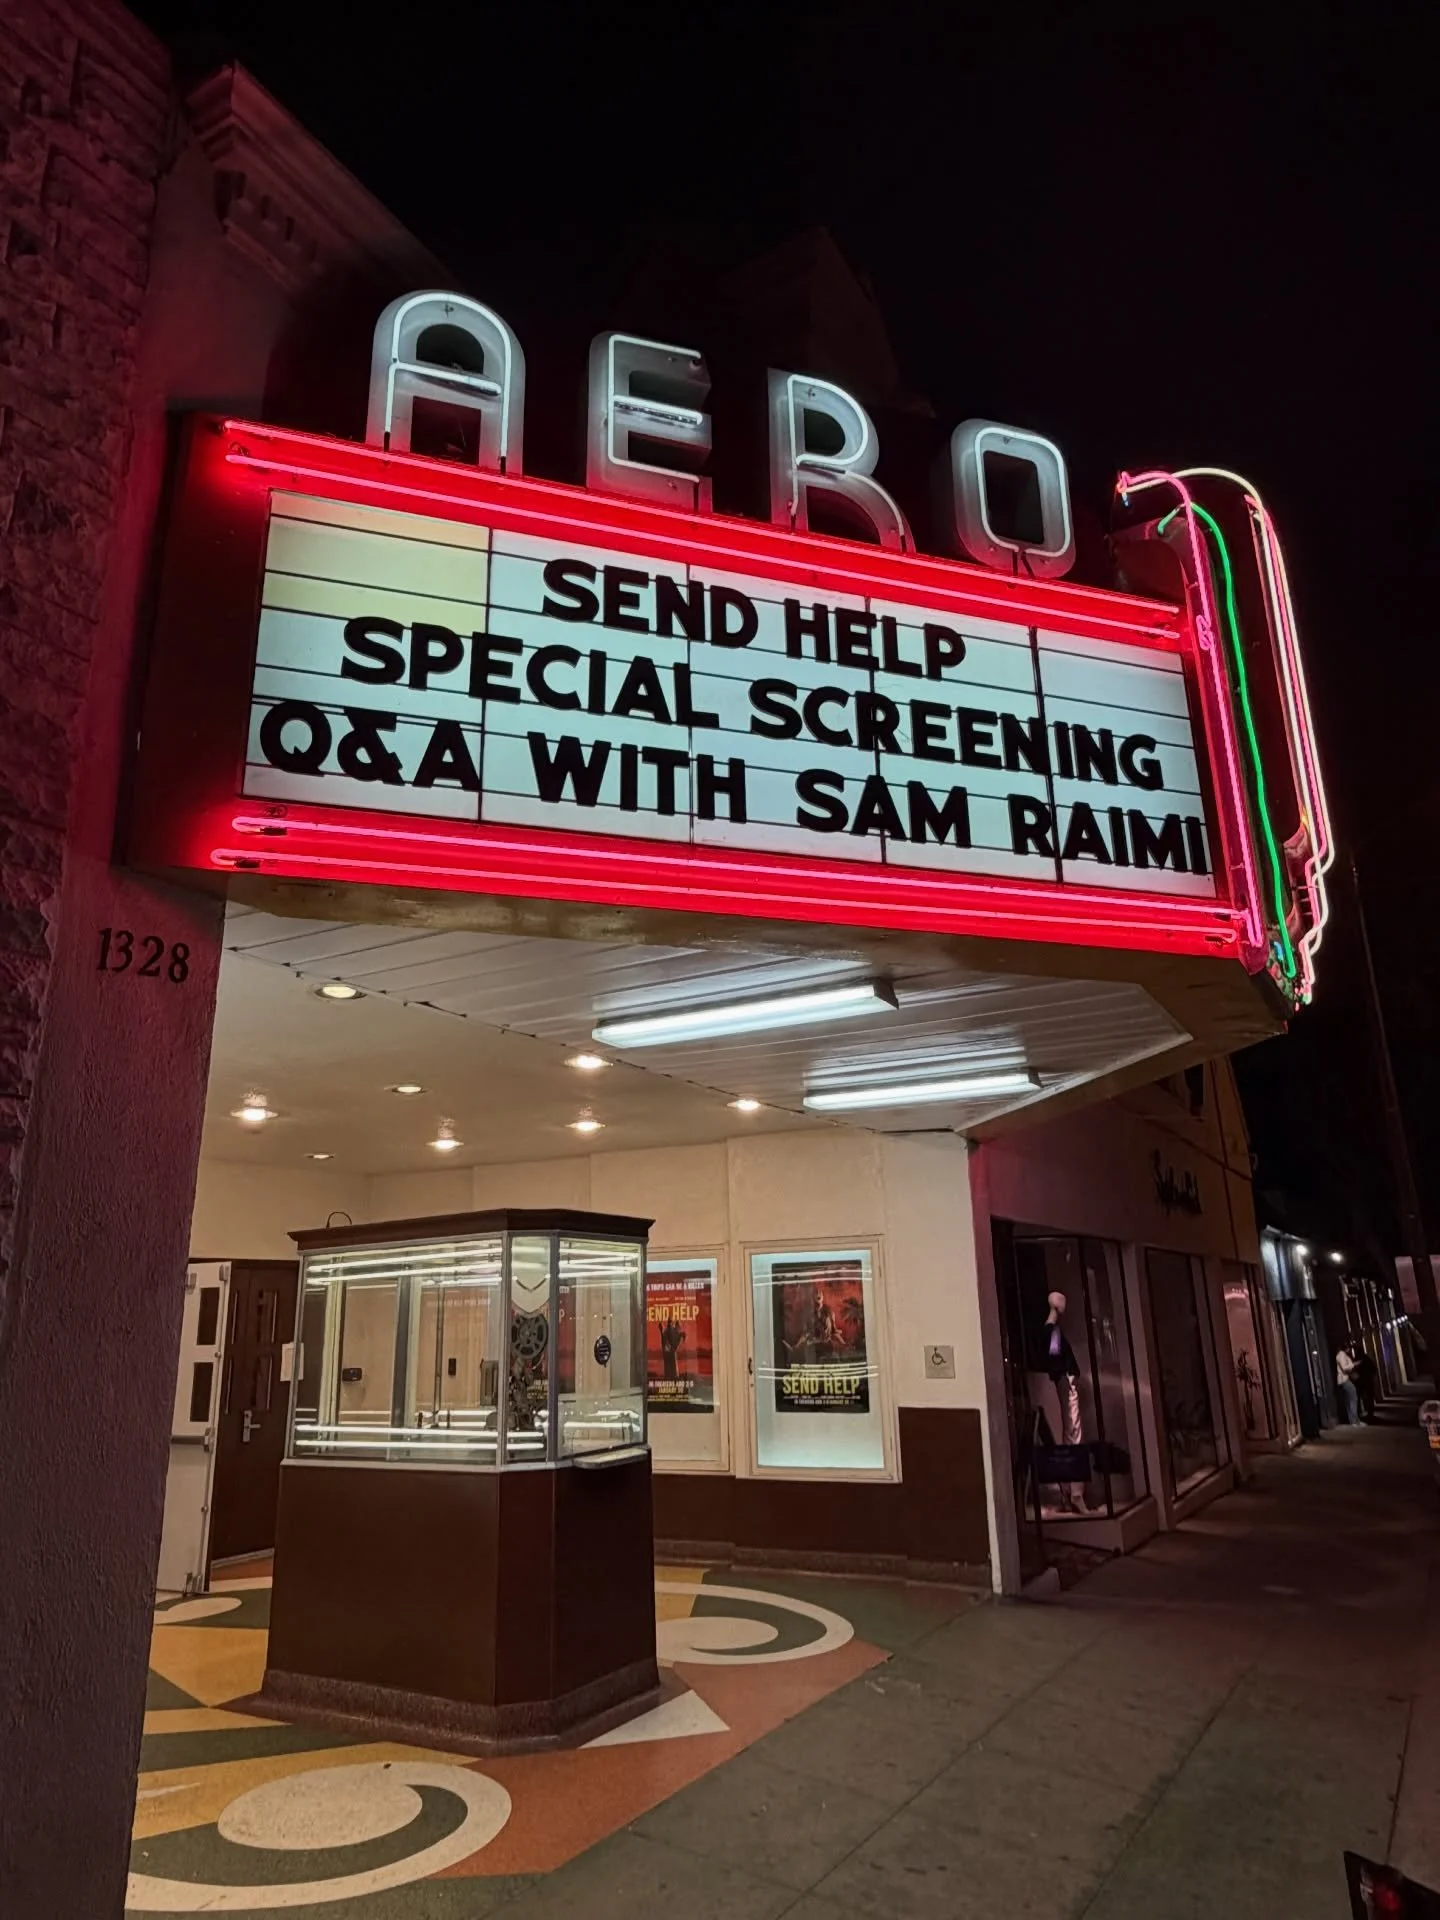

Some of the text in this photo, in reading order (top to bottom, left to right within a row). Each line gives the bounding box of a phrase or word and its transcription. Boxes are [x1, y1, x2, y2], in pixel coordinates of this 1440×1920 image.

[366, 289, 1077, 580] AERO
[542, 557, 967, 681] SEND HELP
[340, 615, 1165, 792] SPECIAL SCREENING
[259, 697, 1208, 877] Q&A WITH SAM RAIMI
[96, 927, 190, 983] 1328
[672, 1303, 700, 1321] HELP
[782, 1375, 860, 1395] SEND HELP
